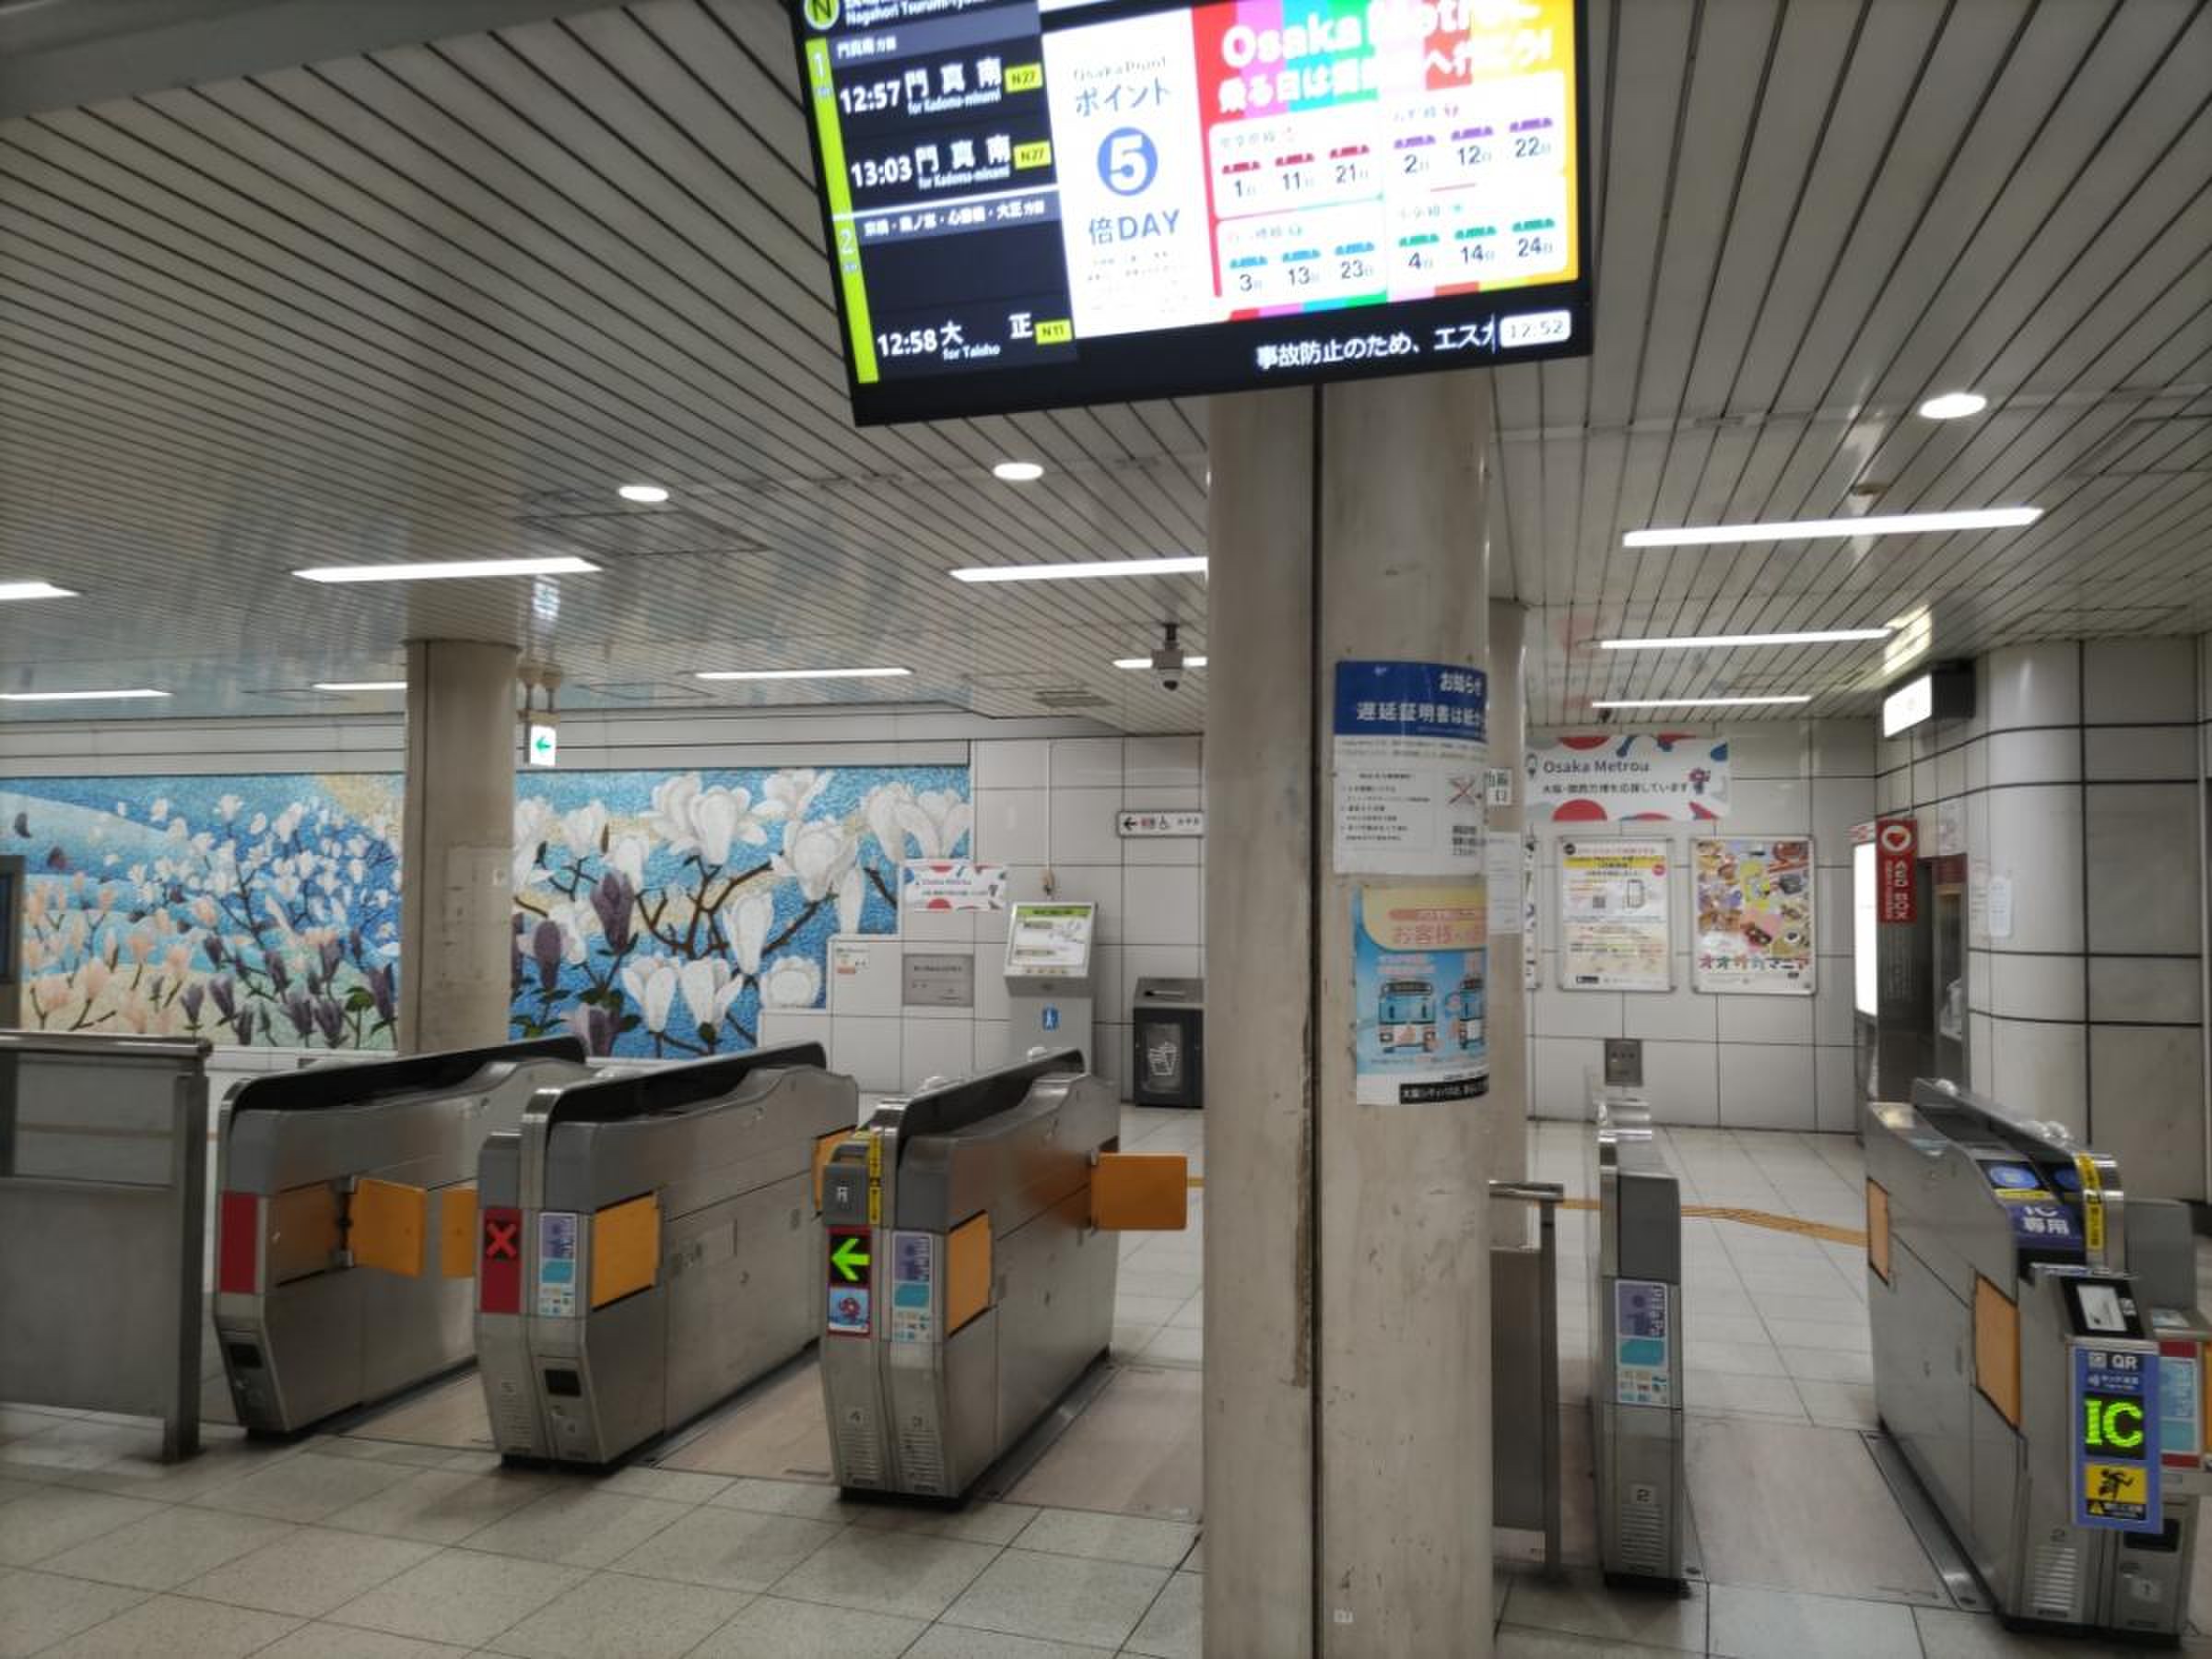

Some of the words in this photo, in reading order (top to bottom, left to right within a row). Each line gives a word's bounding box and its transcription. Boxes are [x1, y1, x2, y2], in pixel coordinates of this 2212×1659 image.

[1222, 13, 1361, 66] Osaka
[1010, 71, 1037, 85] N27
[840, 80, 900, 114] 12:57
[1076, 76, 1171, 117] ポイント
[1020, 148, 1045, 162] N27
[1110, 135, 1148, 193] 5
[852, 157, 912, 188] 13:03
[840, 229, 853, 254] 2
[1089, 209, 1180, 245] 倍DAY
[877, 329, 937, 358] 12:58
[1511, 319, 1563, 340] 12:52
[1543, 759, 1592, 774] Osaka
[2112, 1355, 2138, 1371] QR
[2085, 1399, 2144, 1448] IC
